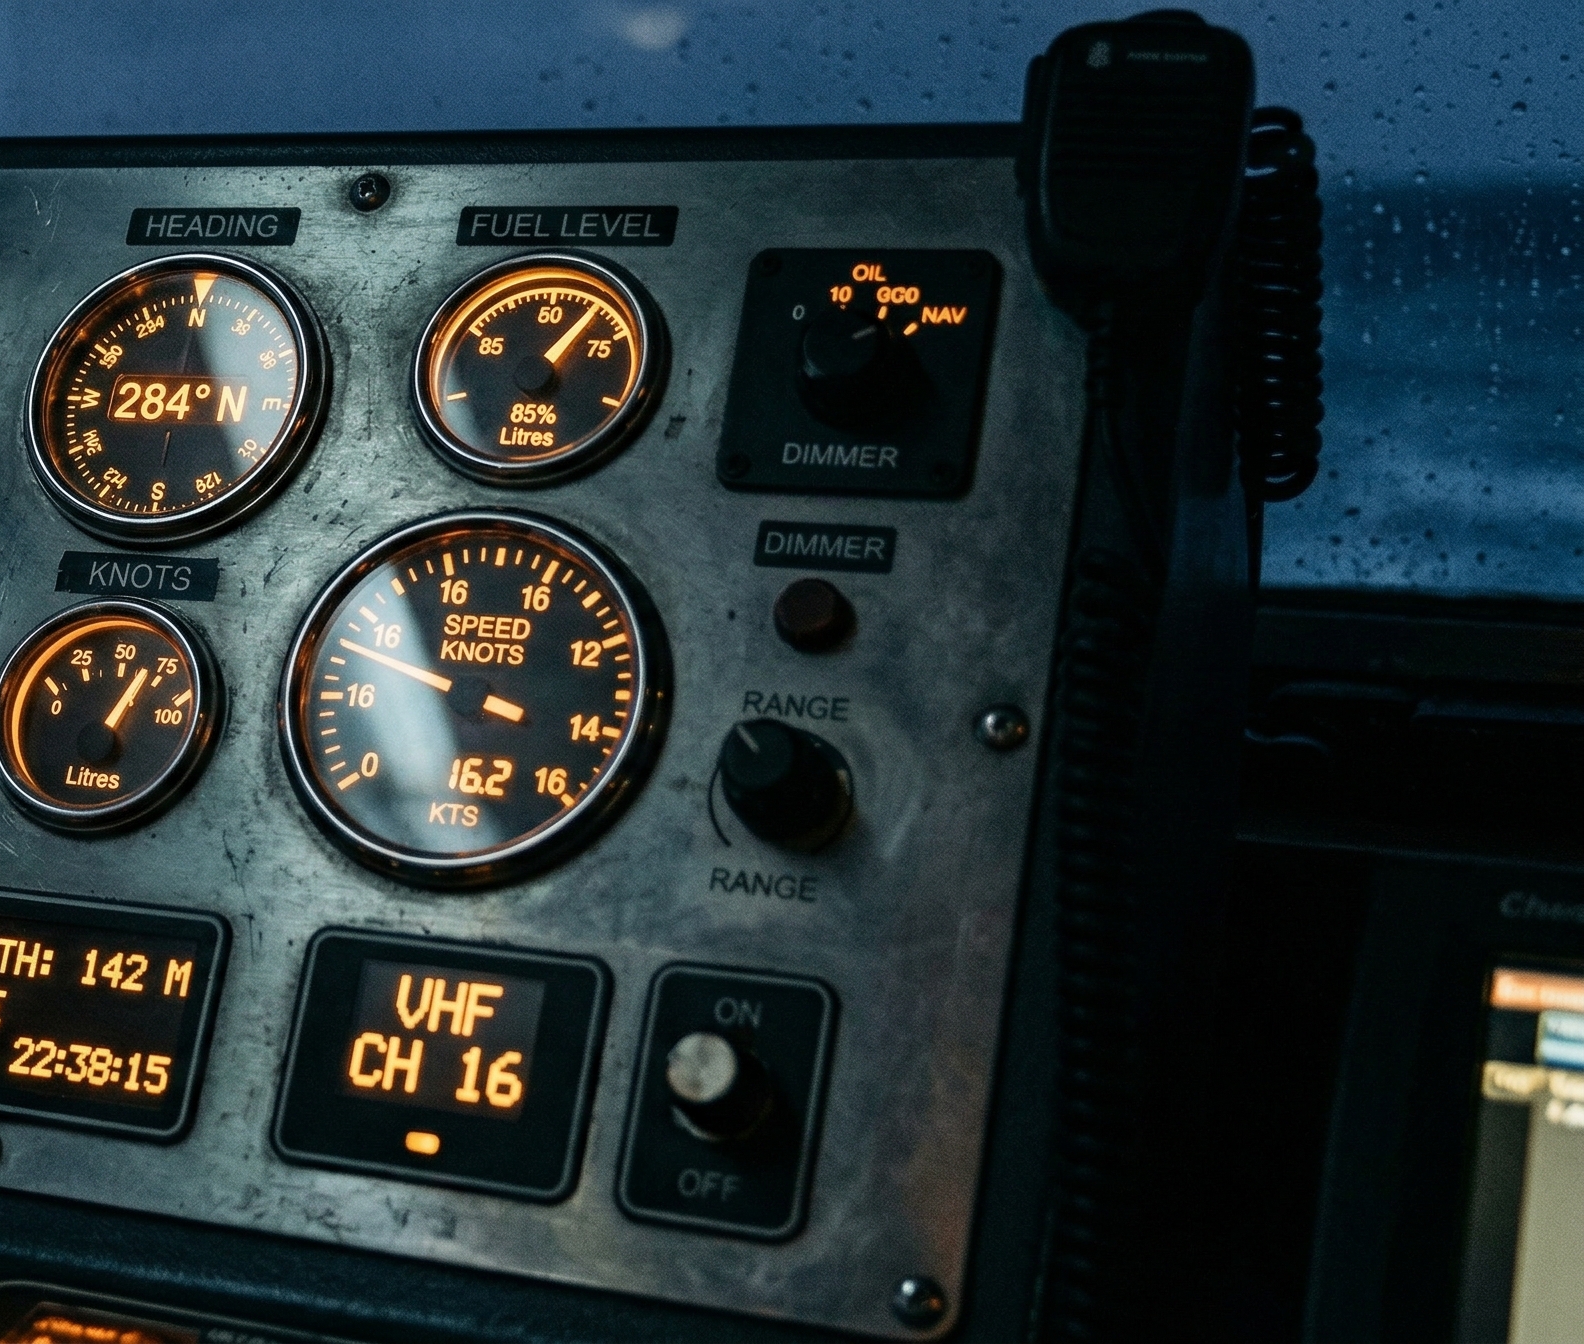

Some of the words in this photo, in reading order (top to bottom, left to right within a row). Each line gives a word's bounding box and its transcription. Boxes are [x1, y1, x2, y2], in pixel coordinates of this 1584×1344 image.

[145, 214, 279, 238] HEADING
[470, 213, 550, 238] FUEL
[560, 213, 660, 238] LEVEL
[852, 264, 887, 282] OIL
[830, 286, 853, 303] 10
[188, 308, 206, 327] N
[921, 306, 967, 324] NAV
[479, 337, 504, 355] 85
[587, 340, 611, 358] 75
[81, 388, 101, 409] W
[114, 382, 210, 420] 284°
[216, 385, 248, 422] N
[262, 398, 281, 411] E
[510, 403, 557, 424] 85%
[499, 427, 554, 446] Litres
[782, 443, 899, 468] DIMMER
[151, 482, 166, 500] S
[764, 531, 886, 561] DIMMER
[89, 561, 192, 591] KNOTS
[440, 580, 469, 605] 16
[521, 586, 551, 612] 16
[373, 624, 402, 649] 16
[443, 614, 531, 640] SPEED
[71, 650, 93, 666] 25
[115, 644, 136, 660] 50
[440, 640, 525, 666] KNOTS
[571, 641, 602, 667] 12
[157, 658, 178, 675] 75
[51, 700, 62, 715] 0
[346, 683, 376, 709] 16
[742, 690, 849, 722] RANGE
[154, 708, 183, 725] 100
[570, 715, 600, 742] 14
[65, 766, 120, 789] Litres
[361, 752, 379, 778] 0
[448, 758, 513, 797] 16.2
[535, 767, 568, 796] 16
[428, 802, 479, 828] KTS
[710, 867, 817, 901] RANGE
[81, 949, 148, 992] 142
[164, 959, 193, 997] M
[395, 974, 504, 1037] VHF
[715, 997, 762, 1029] ON
[8, 1037, 171, 1094] 22:38:15
[349, 1032, 424, 1094] CH
[455, 1046, 523, 1108] 16
[677, 1167, 741, 1201] OFF
